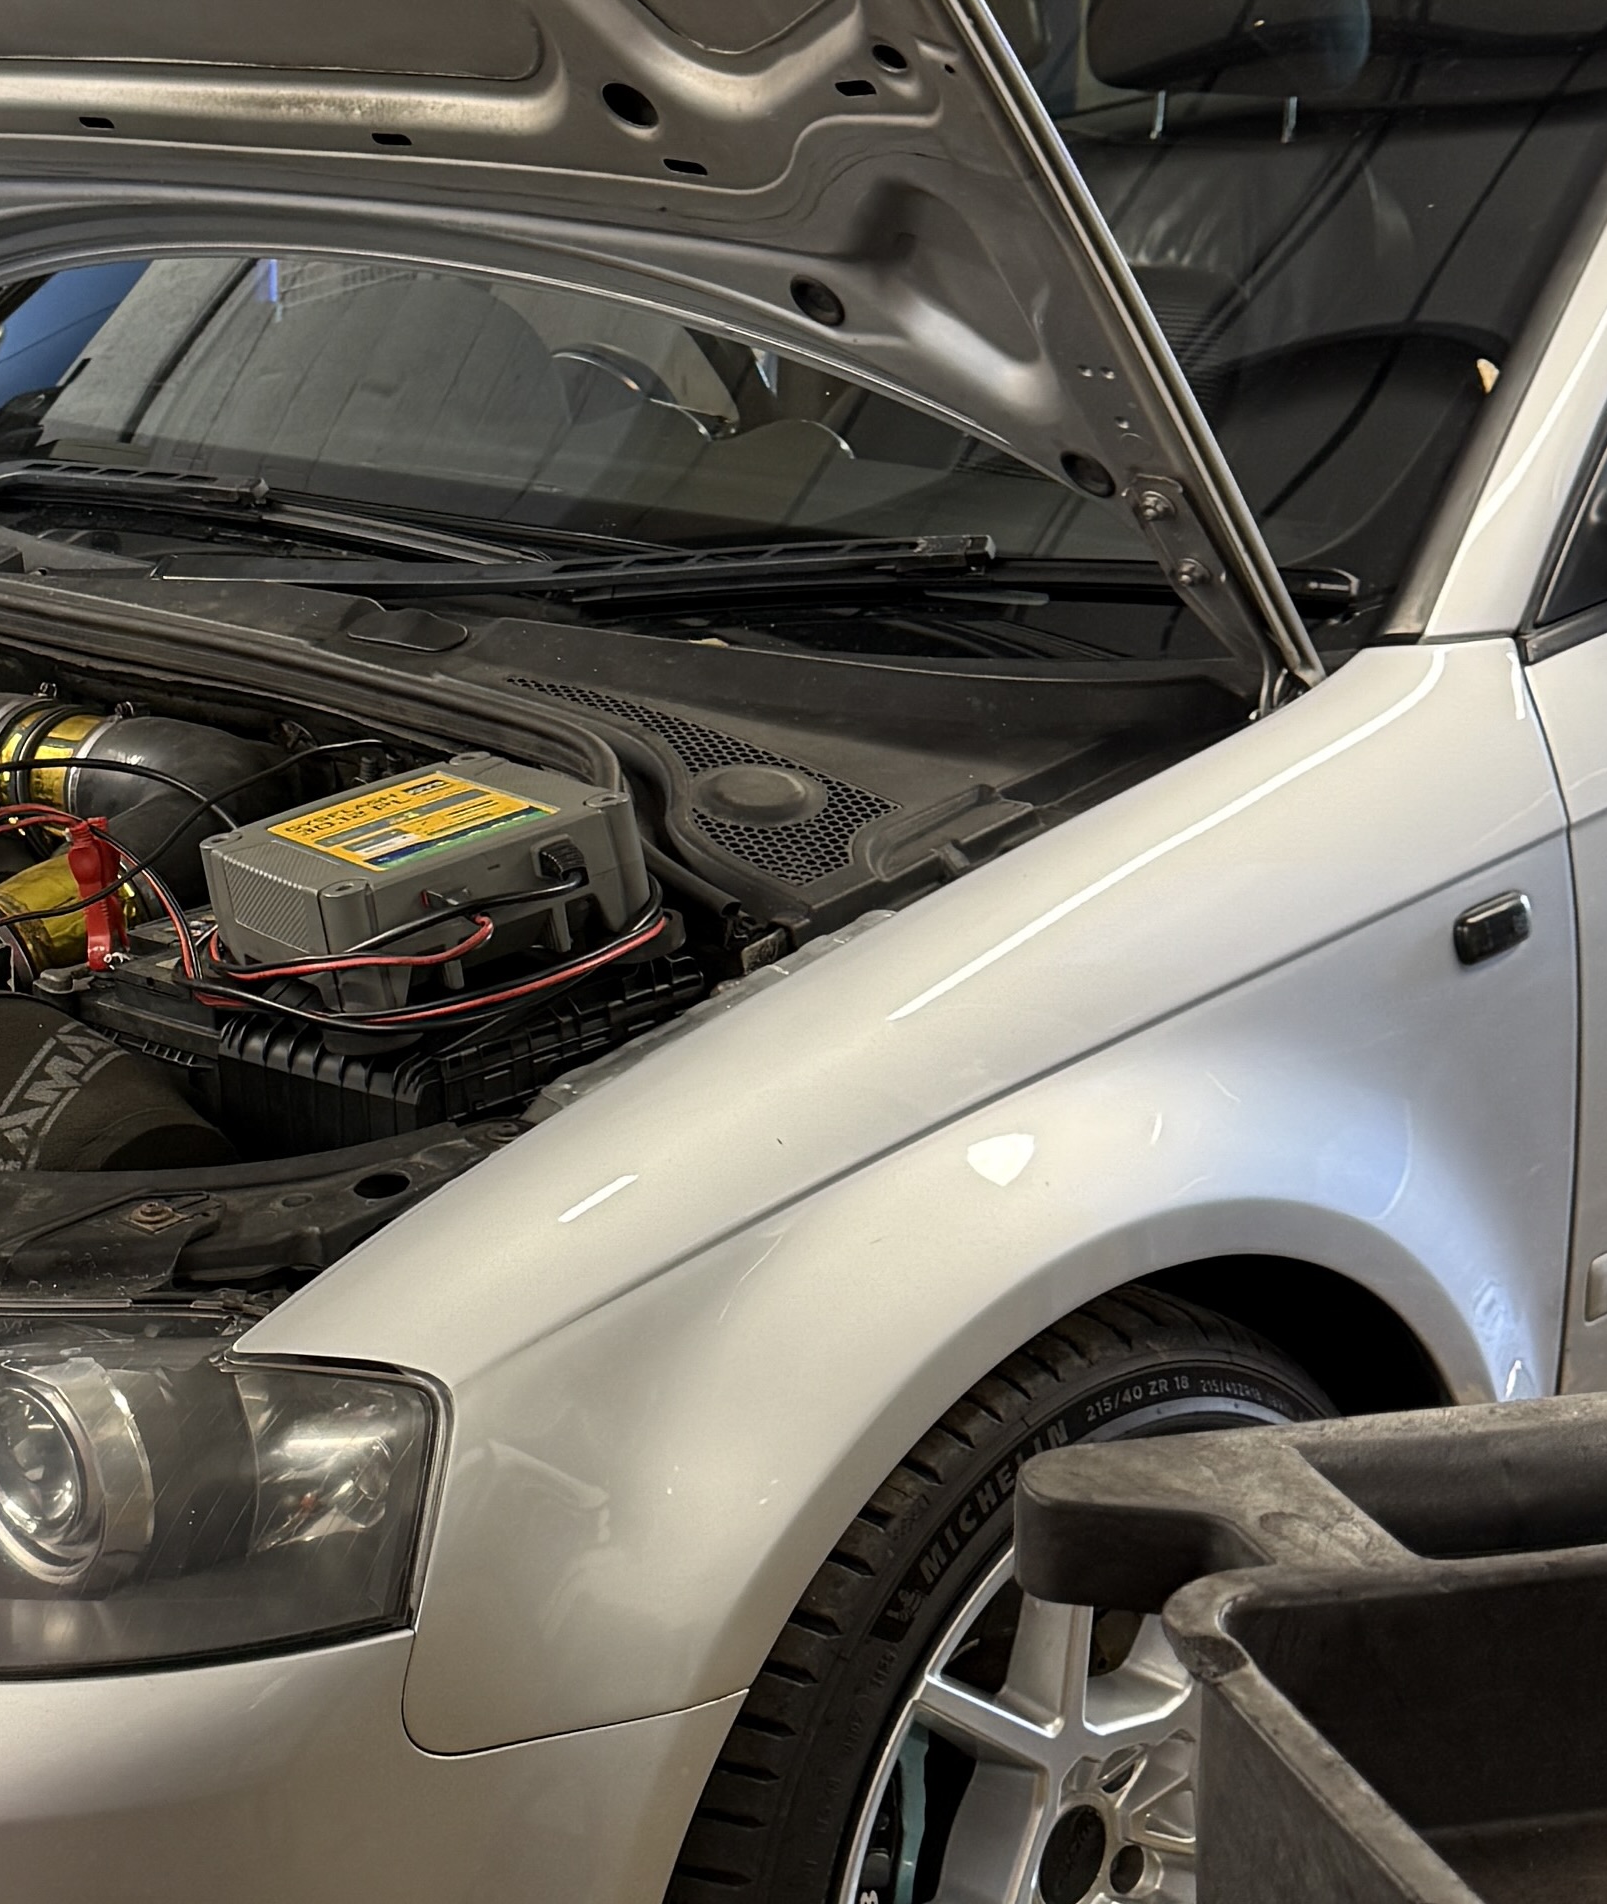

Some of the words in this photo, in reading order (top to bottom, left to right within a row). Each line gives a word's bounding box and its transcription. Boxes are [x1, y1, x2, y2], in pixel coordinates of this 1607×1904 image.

[1086, 1384, 1143, 1422] 215/40
[1148, 1378, 1169, 1396] ZR
[1174, 1375, 1190, 1390] 18
